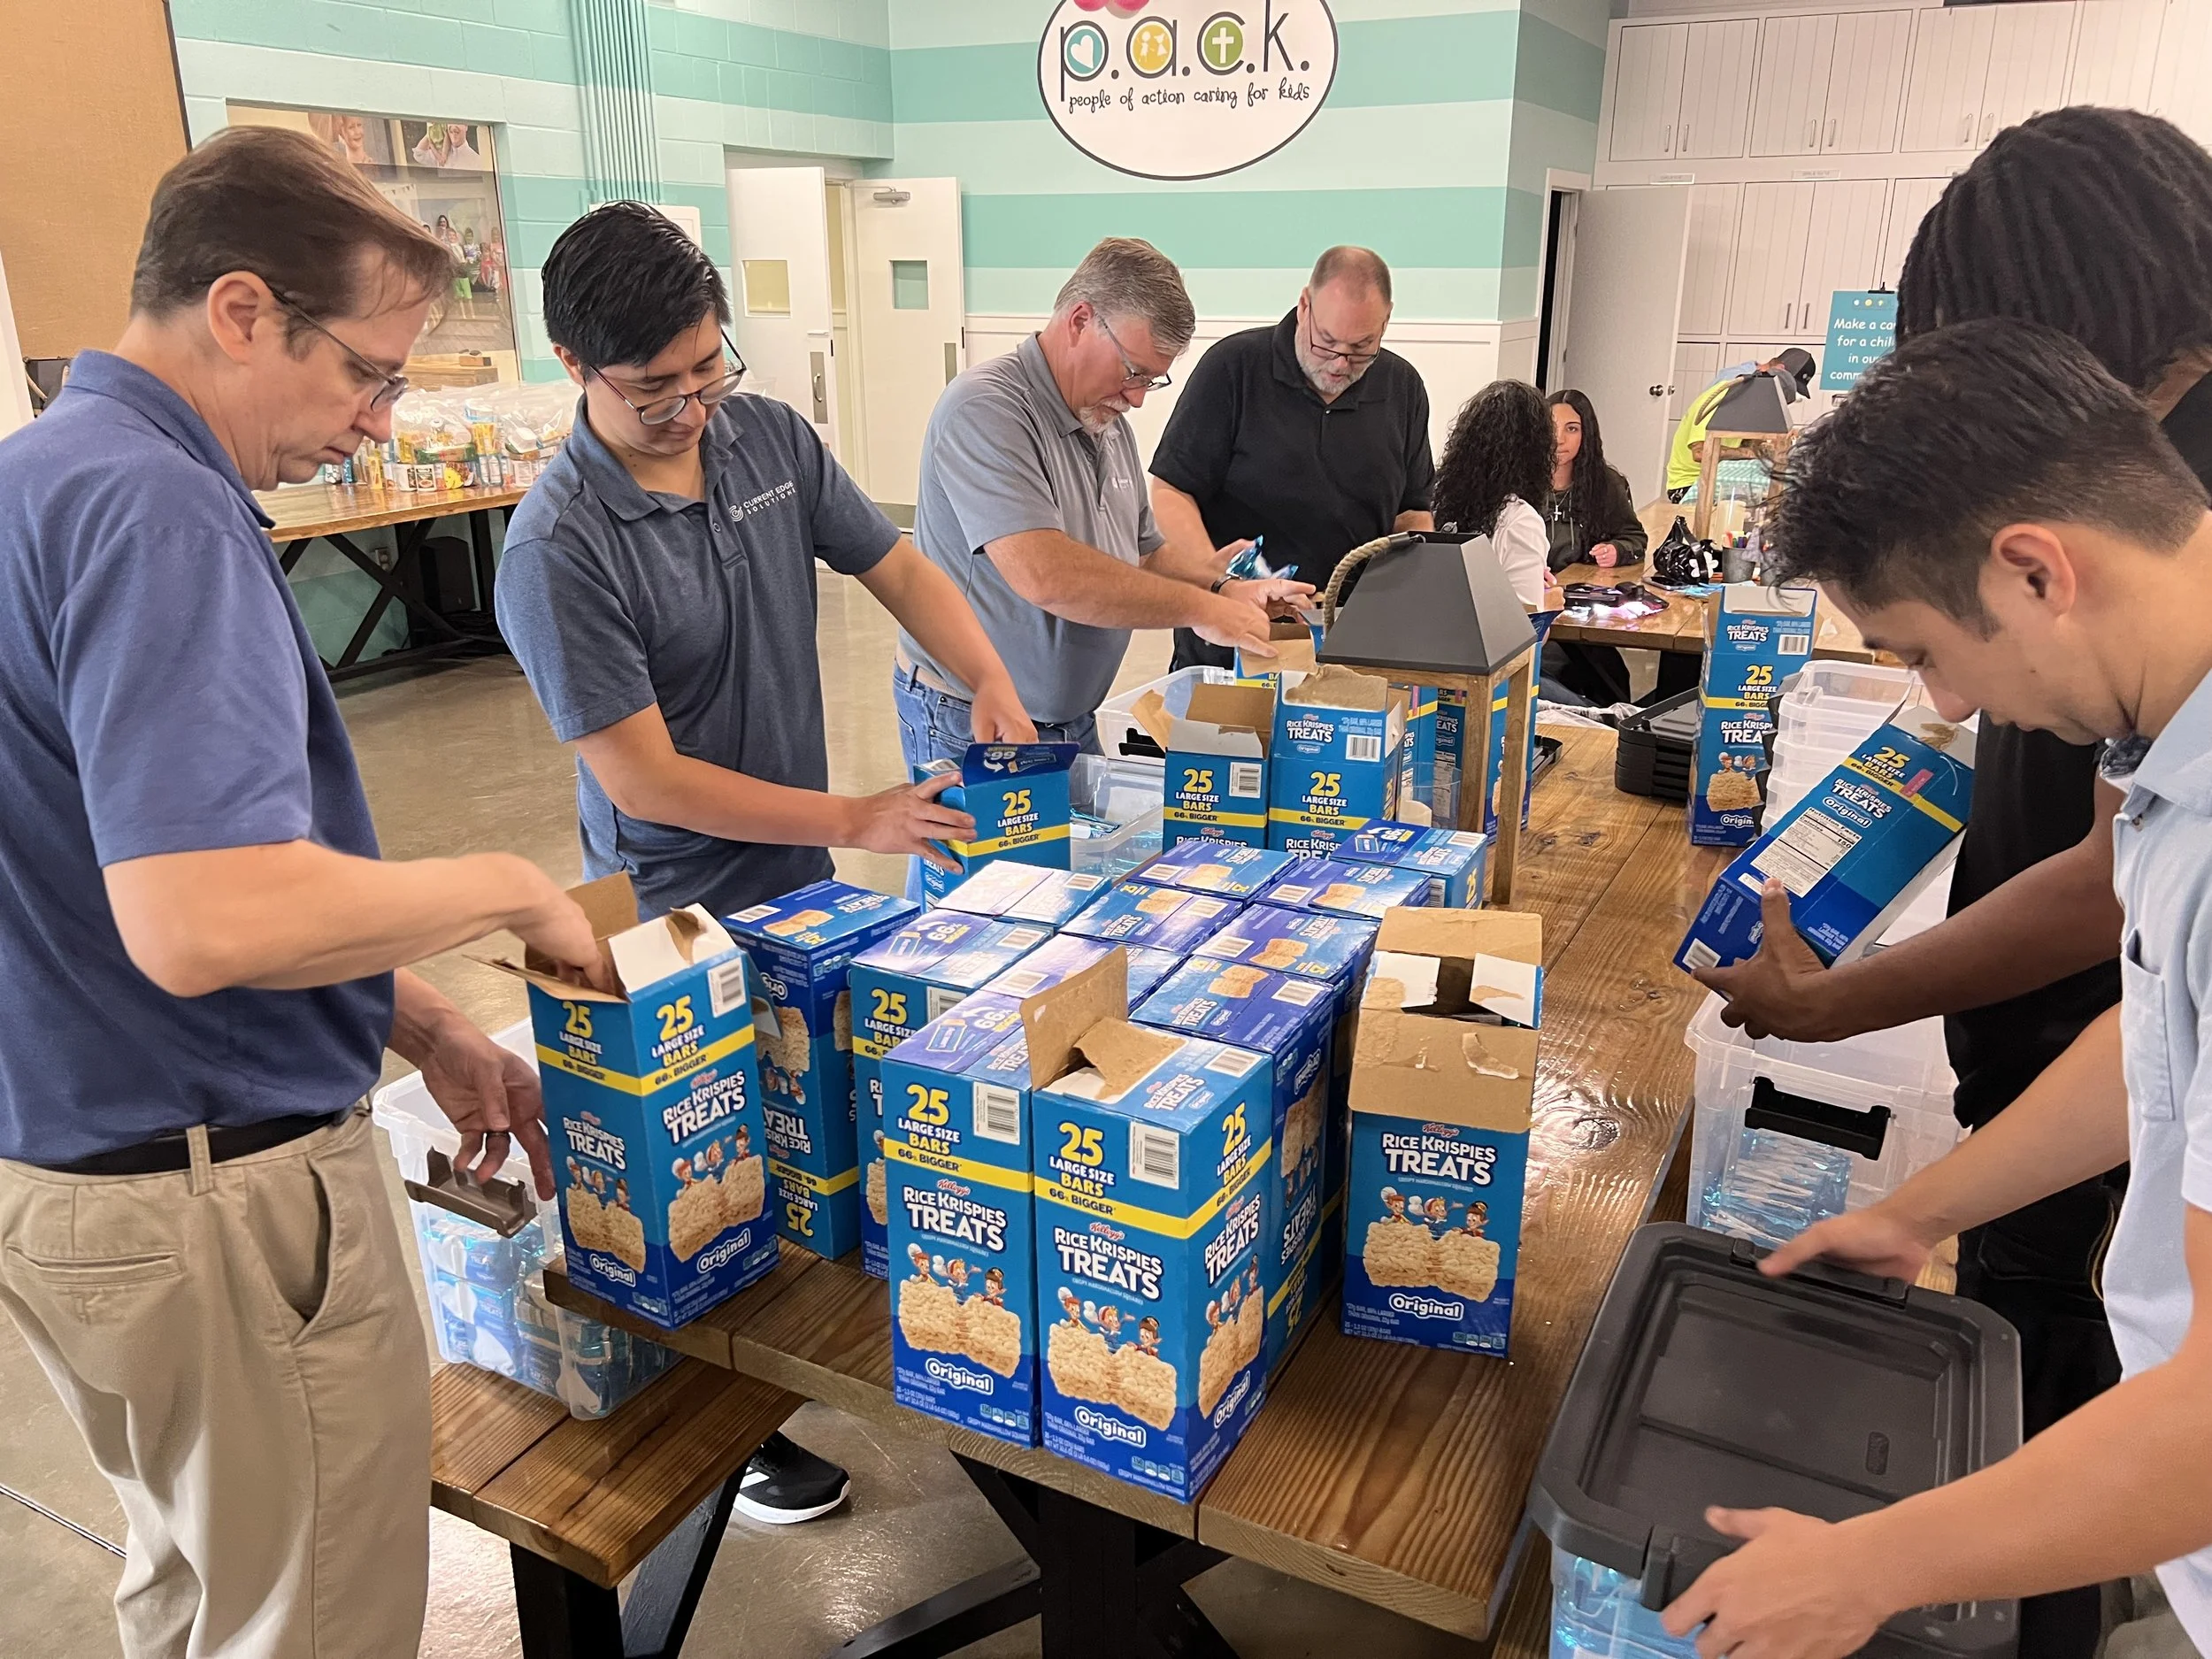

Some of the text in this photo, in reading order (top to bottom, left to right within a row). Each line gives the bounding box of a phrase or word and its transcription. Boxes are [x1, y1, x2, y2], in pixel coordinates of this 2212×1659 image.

[1069, 78, 1310, 113] people of action caring for kids
[1834, 319, 1866, 329] Make
[1837, 335, 1856, 347] for
[1848, 354, 1858, 363] in
[743, 481, 794, 509] CURRENT EDGE
[1727, 630, 1768, 642] TREATS
[1741, 625, 1769, 634] KRISPIES
[1745, 665, 1773, 685] 25
[1743, 692, 1770, 701] BARS
[1286, 719, 1302, 729] RICE
[1302, 719, 1335, 732] KRISPIES
[1286, 726, 1333, 743] TREATS
[1437, 720, 1456, 733] EATS
[1721, 720, 1743, 731] RICE
[1862, 754, 1906, 779] LARGE SIZE
[1865, 762, 1894, 779] BARS
[1874, 747, 1910, 769] 25
[1183, 768, 1213, 794] 25
[1310, 771, 1341, 796] 25
[1002, 789, 1032, 818] 25
[1176, 791, 1220, 803] LARGE SIZE
[1182, 800, 1212, 811] BARS
[1302, 795, 1348, 807] LARGE SIZE
[1832, 786, 1886, 818] TREATS
[1835, 779, 1893, 813] RICE KRISPIES
[997, 813, 1039, 828] LARGE SIZE
[1309, 803, 1340, 817] BARS
[1722, 815, 1754, 825] Origin
[1825, 798, 1870, 826] Original
[1005, 822, 1033, 837] BARS
[1286, 838, 1310, 849] RICE
[1838, 839, 1852, 849] 150
[1113, 915, 1143, 937] TREATS
[657, 995, 695, 1041] 25
[872, 988, 907, 1025] 25
[1182, 1001, 1217, 1026] TREATS
[562, 1001, 593, 1039] 25
[864, 1018, 895, 1033] LARGE
[559, 1031, 583, 1049] LARGE
[651, 1025, 704, 1057] LARGE SIZE
[568, 1046, 597, 1065] BARS
[663, 1042, 698, 1067] BARS
[664, 1071, 745, 1125] RICE KRISPIES
[907, 1084, 949, 1125] 25
[1158, 1076, 1206, 1111] TREATS
[666, 1090, 746, 1143] TREATS
[764, 1107, 809, 1140] TREA
[563, 1118, 625, 1150] RICE KRISPIES
[766, 1127, 811, 1154] RICE KRIS
[898, 1118, 960, 1142] LARGE SIZE
[1222, 1102, 1246, 1157] 25
[1422, 1122, 1460, 1137] Kellogg's
[567, 1129, 626, 1170] TREATS
[909, 1133, 950, 1155] BARS
[1059, 1122, 1103, 1167] 25
[1217, 1134, 1252, 1177] LARGE SIZE
[1382, 1133, 1496, 1163] RICE KRISPIES
[1049, 1156, 1115, 1186] LARGE SIZE
[1224, 1153, 1247, 1187] BARS
[1386, 1148, 1492, 1186] TREATS
[783, 1178, 810, 1199] BARS
[937, 1179, 972, 1195] Kellogg's
[1061, 1172, 1104, 1197] BARS
[778, 1187, 818, 1211] LARGE SIZE
[903, 1187, 1007, 1227] RICE KRISPIES
[787, 1203, 813, 1236] 25
[906, 1203, 1005, 1251] TREATS
[1089, 1222, 1125, 1240] Kellogg's
[1205, 1194, 1260, 1263] RICE KRISPIES
[699, 1230, 750, 1271] Original
[1055, 1228, 1163, 1276] RICE KRISPIES
[1207, 1212, 1259, 1284] TREATS
[591, 1256, 635, 1285] Original
[1058, 1244, 1160, 1299] TREATS
[1393, 1297, 1460, 1318] Original
[928, 1362, 990, 1391] Original
[1215, 1375, 1249, 1425] Original
[1078, 1409, 1142, 1444] Original
